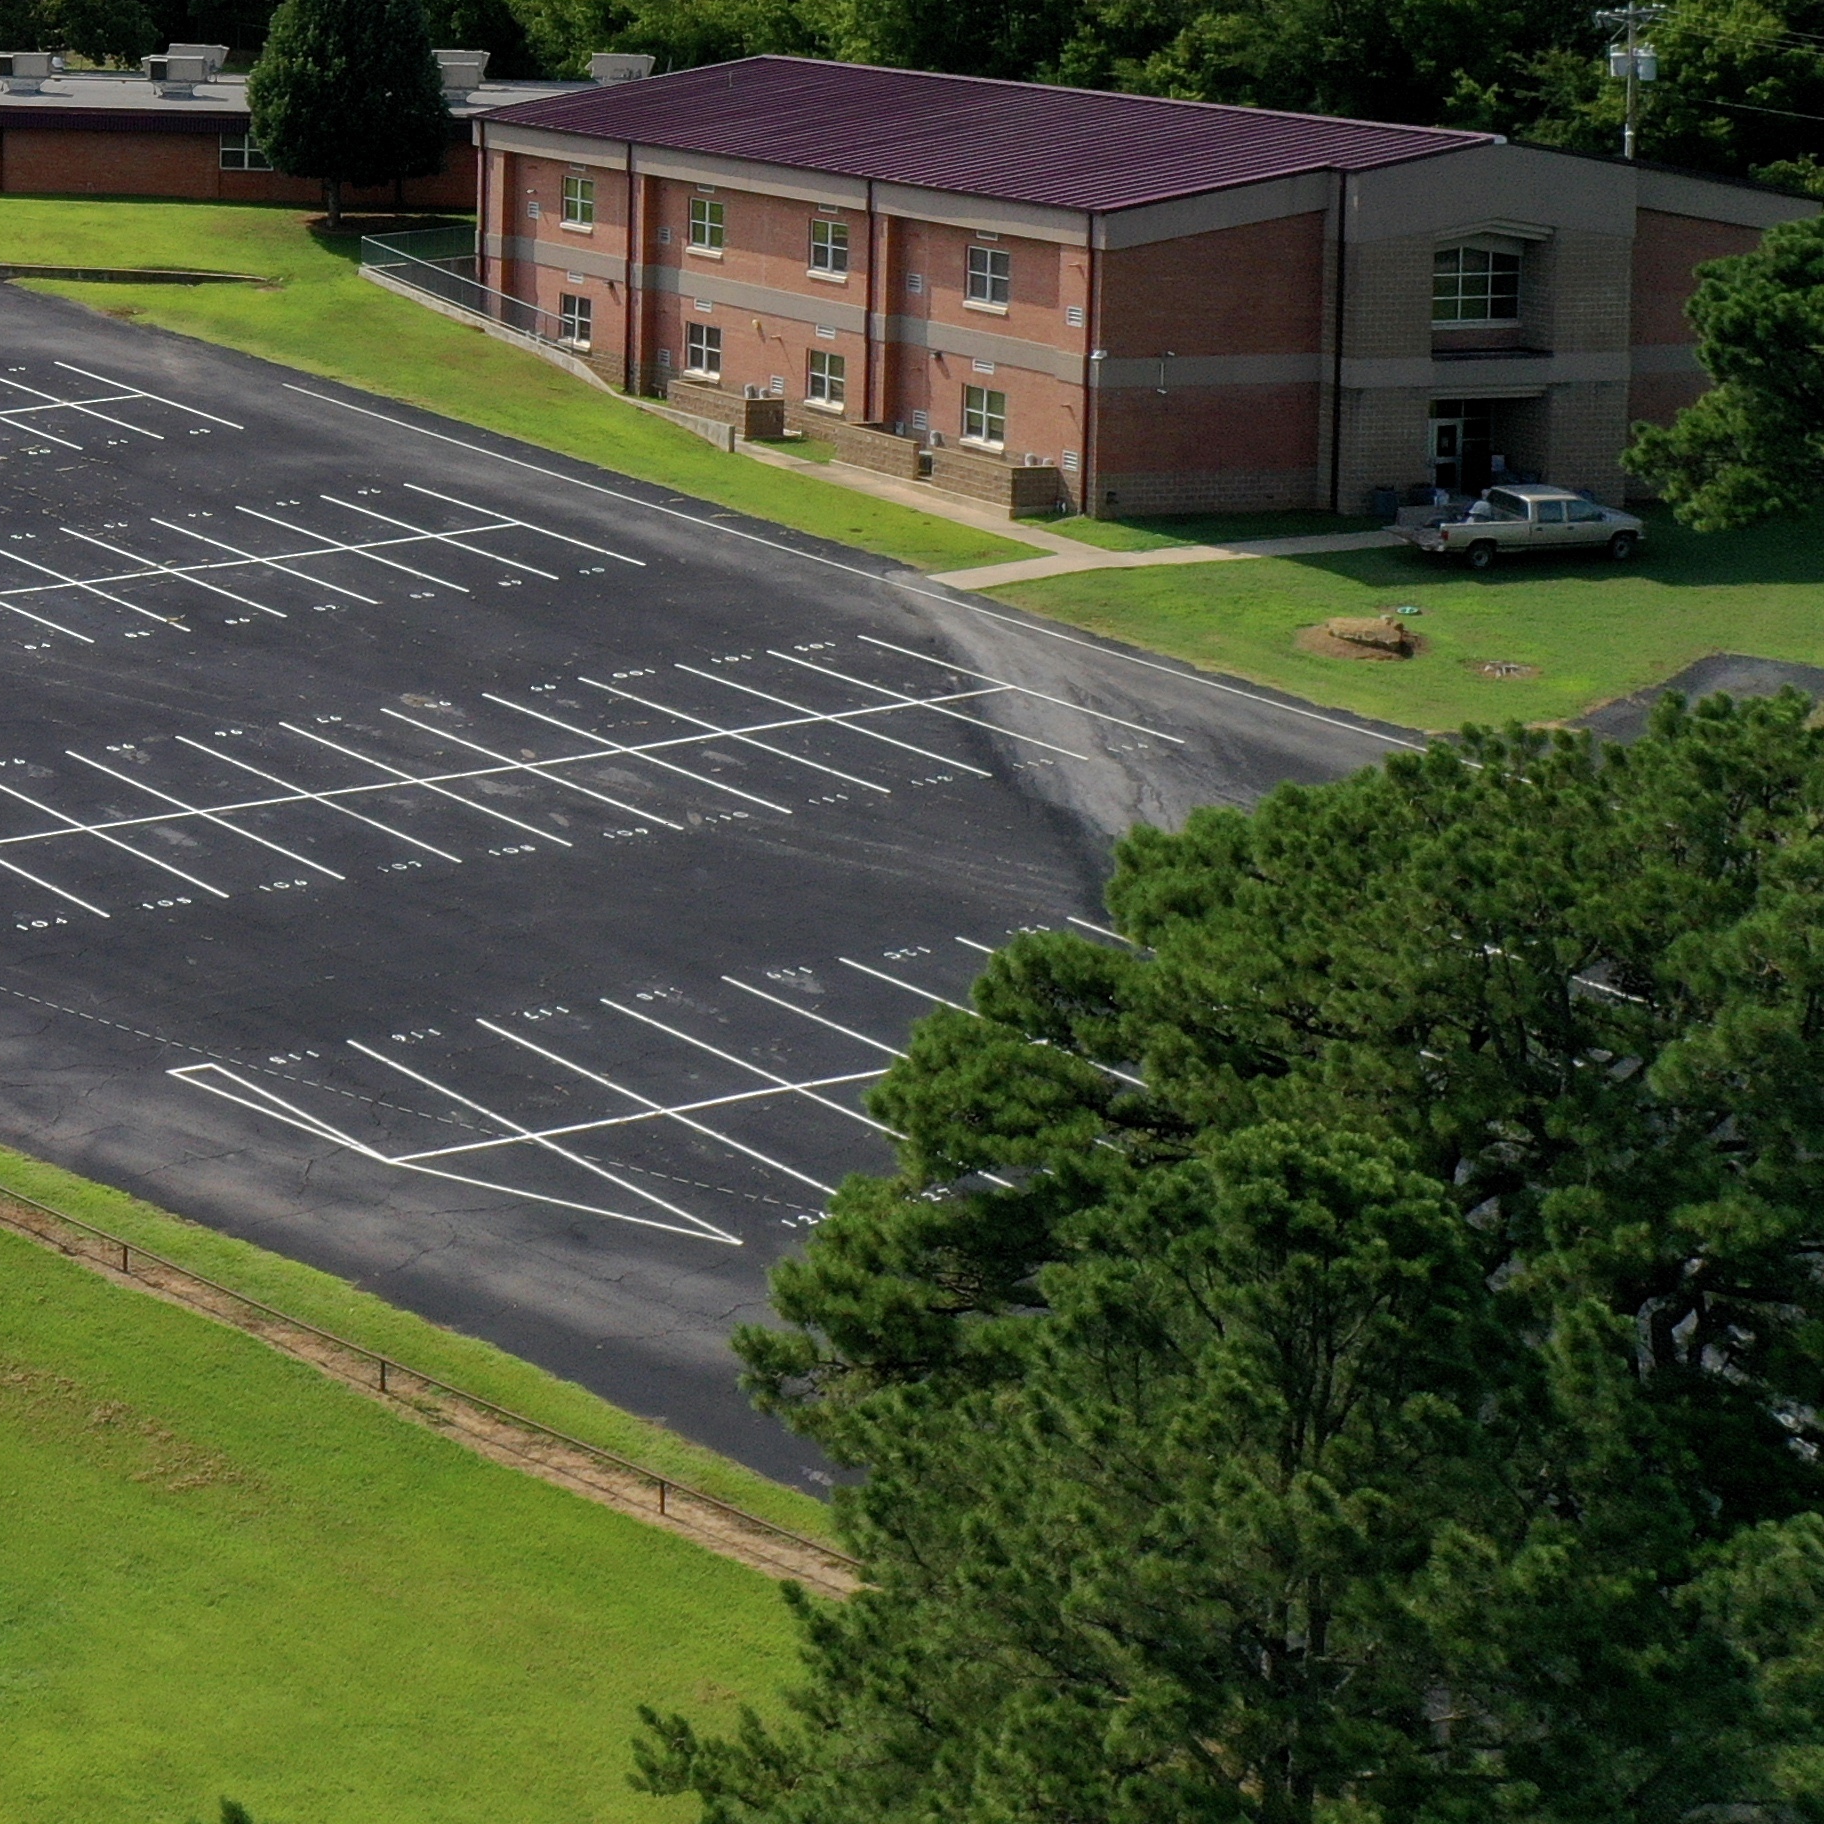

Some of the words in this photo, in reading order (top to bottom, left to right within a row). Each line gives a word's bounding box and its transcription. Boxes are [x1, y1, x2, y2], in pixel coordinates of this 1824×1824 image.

[377, 860, 422, 873] 107
[258, 879, 308, 892] 106
[16, 917, 68, 931] 104
